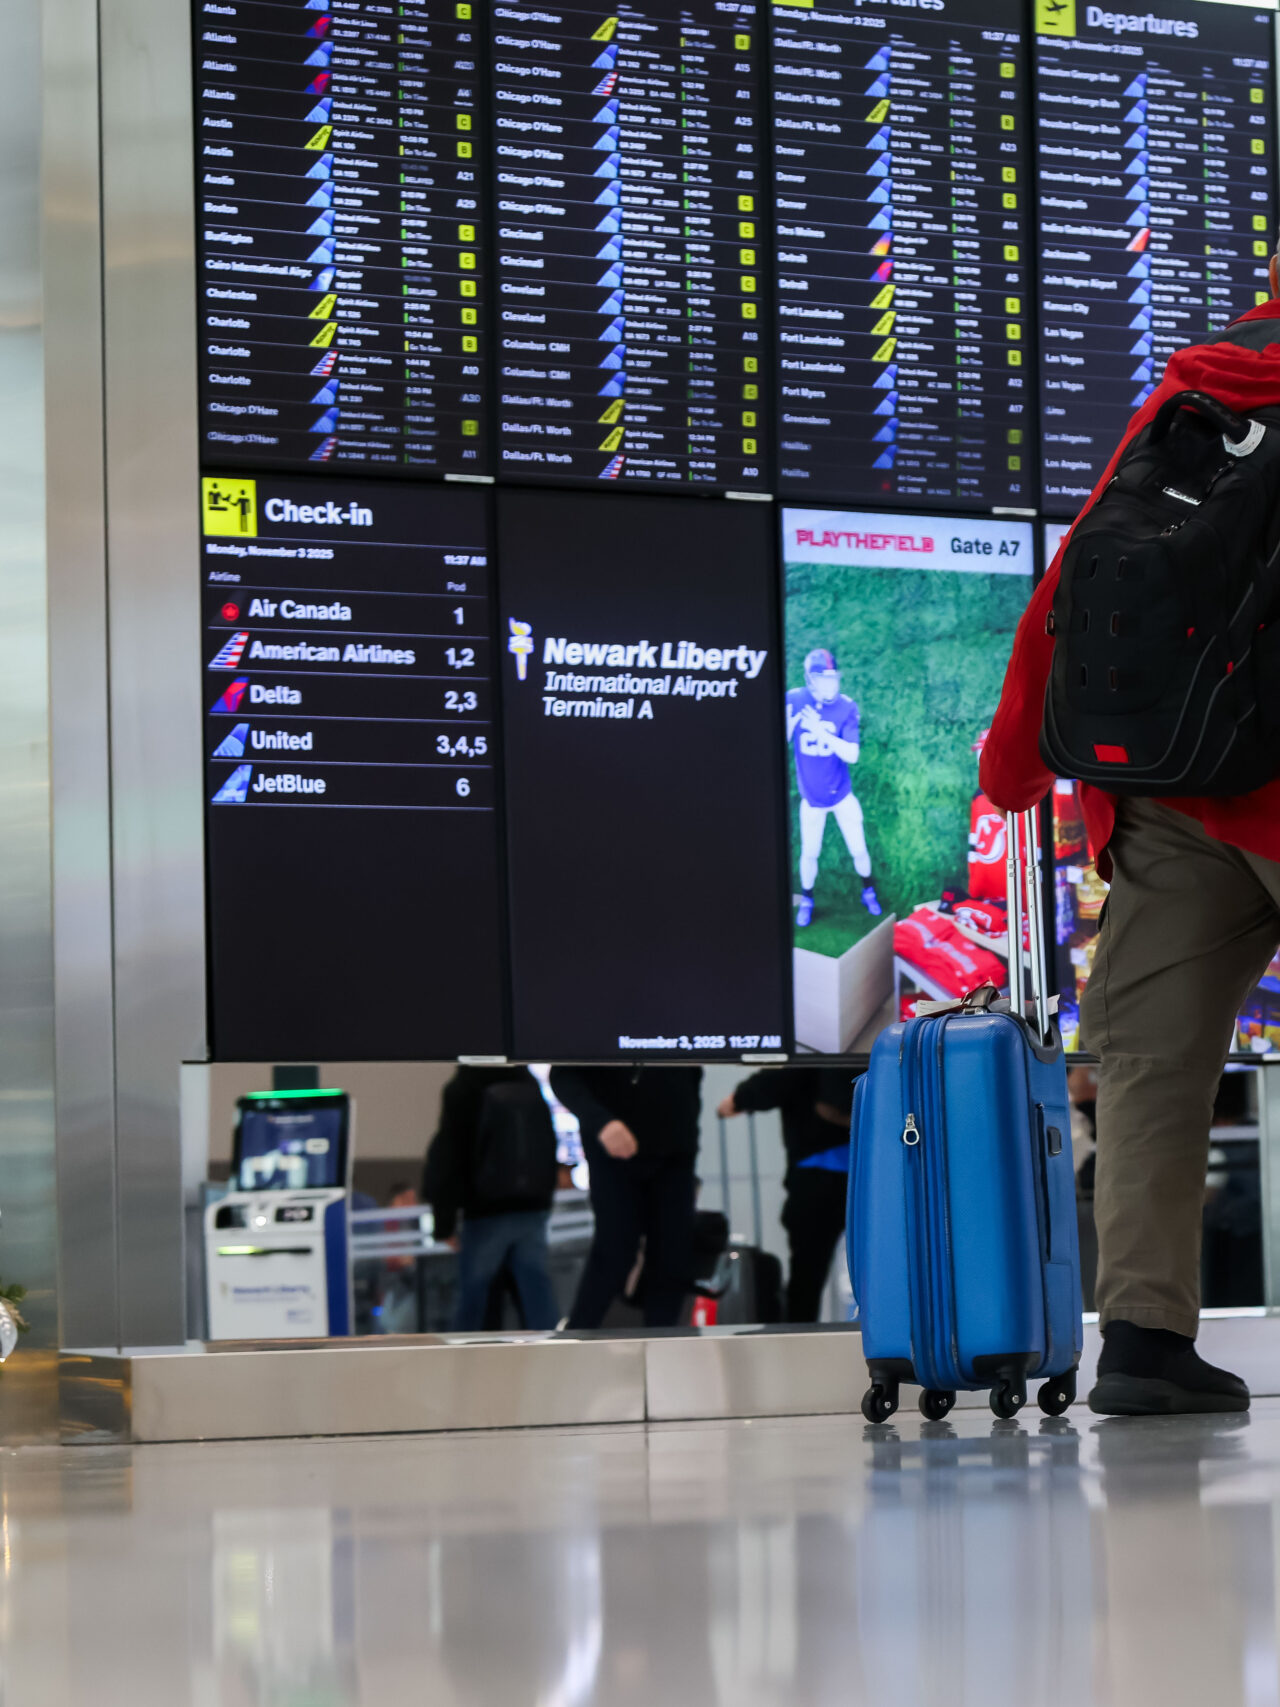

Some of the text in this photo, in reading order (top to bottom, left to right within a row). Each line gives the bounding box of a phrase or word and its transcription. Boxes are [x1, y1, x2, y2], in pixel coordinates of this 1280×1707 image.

[203, 4, 236, 16] Atlanta
[1086, 6, 1199, 38] Departures
[495, 35, 562, 51] Chicago O'Hare
[495, 63, 561, 78] Chicago O'Hare
[202, 88, 236, 101] Atlanta
[496, 90, 562, 105] Chicago O'Hare
[202, 117, 233, 129] Austin
[203, 146, 234, 158] Austin
[203, 174, 234, 186] Austin
[204, 203, 238, 214] Boston
[207, 317, 250, 329] Charlotte
[502, 311, 545, 323] Cleveland
[208, 346, 250, 358] Charlotte
[503, 339, 546, 351] Columbus
[209, 374, 251, 386] Charlotte
[210, 402, 279, 416] Chicago O'Hare
[547, 453, 572, 463] Worth
[265, 498, 373, 526] Check-in
[950, 537, 1020, 556] Gate A7
[206, 544, 487, 566] Monday, November 3 2025 11:37 AM
[209, 572, 467, 593] Airline Pod
[248, 599, 464, 625] Air Canada 1
[249, 641, 475, 669] American Airlines 1,2
[543, 638, 767, 679] Newark Liberty
[544, 671, 738, 701] International Airport
[250, 685, 477, 712] Delta 2,3
[542, 697, 653, 719] Terminal A
[251, 730, 487, 757] United 3,4,5
[252, 774, 470, 797] JetBlue 6
[618, 1036, 781, 1050] November 3, 2025 11:37 AM
